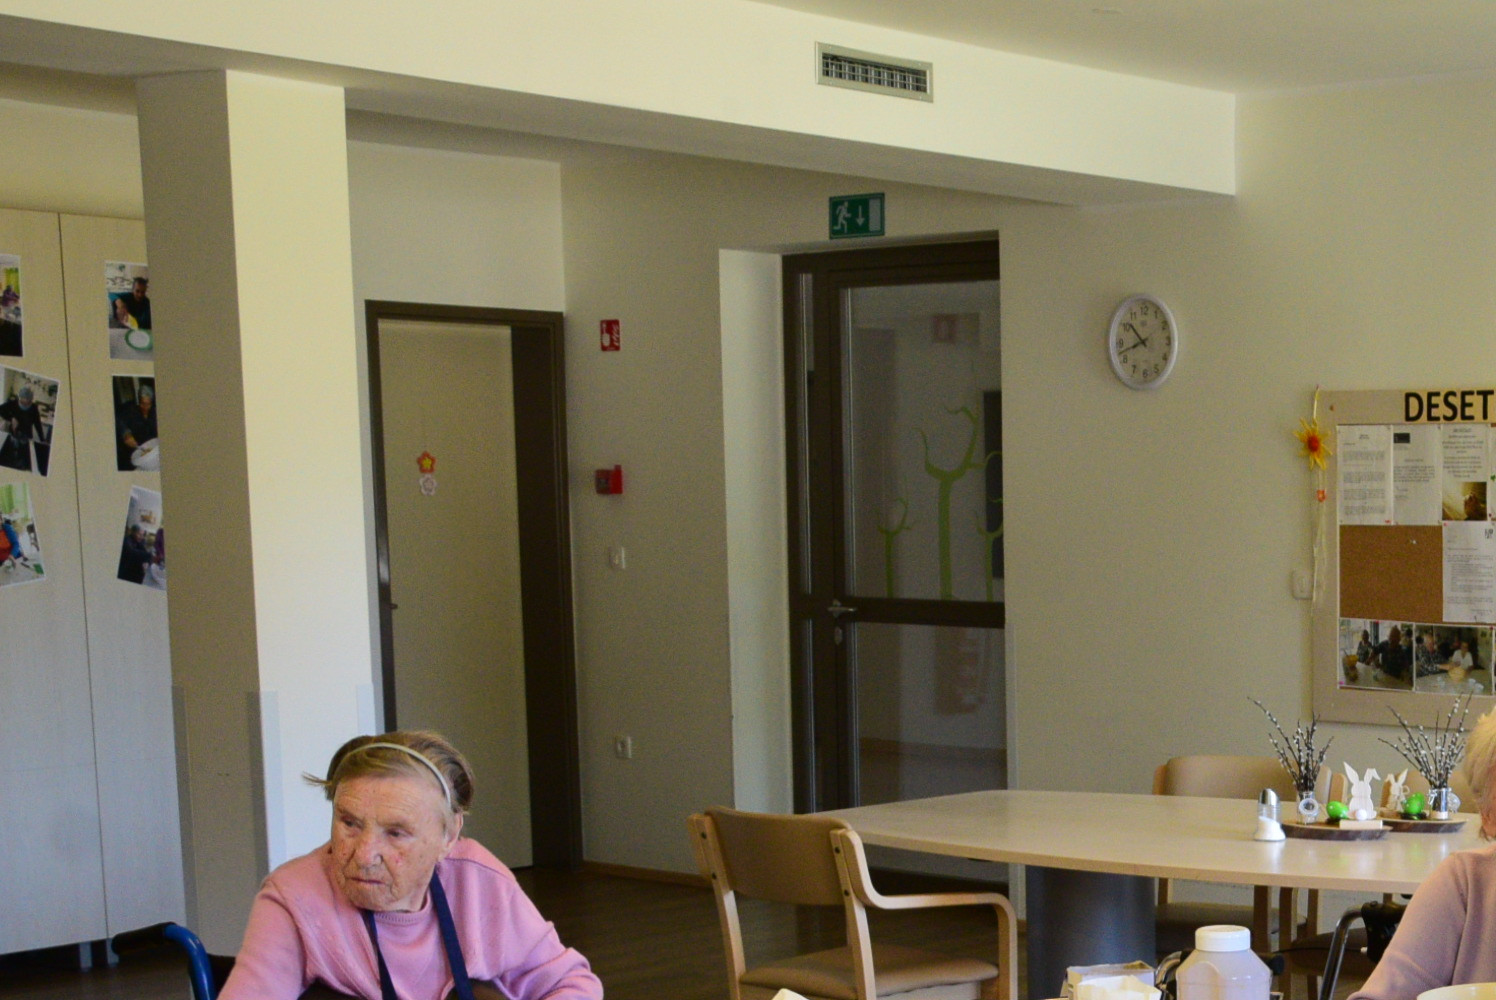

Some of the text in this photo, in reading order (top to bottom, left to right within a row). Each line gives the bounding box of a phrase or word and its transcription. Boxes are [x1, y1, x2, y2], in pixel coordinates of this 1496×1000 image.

[1140, 305, 1149, 315] 12
[1130, 312, 1136, 320] 11
[1123, 323, 1130, 332] 10
[1118, 338, 1124, 348] 9
[1123, 354, 1128, 364] 8
[1132, 364, 1136, 374] 7
[1142, 369, 1149, 378] 6
